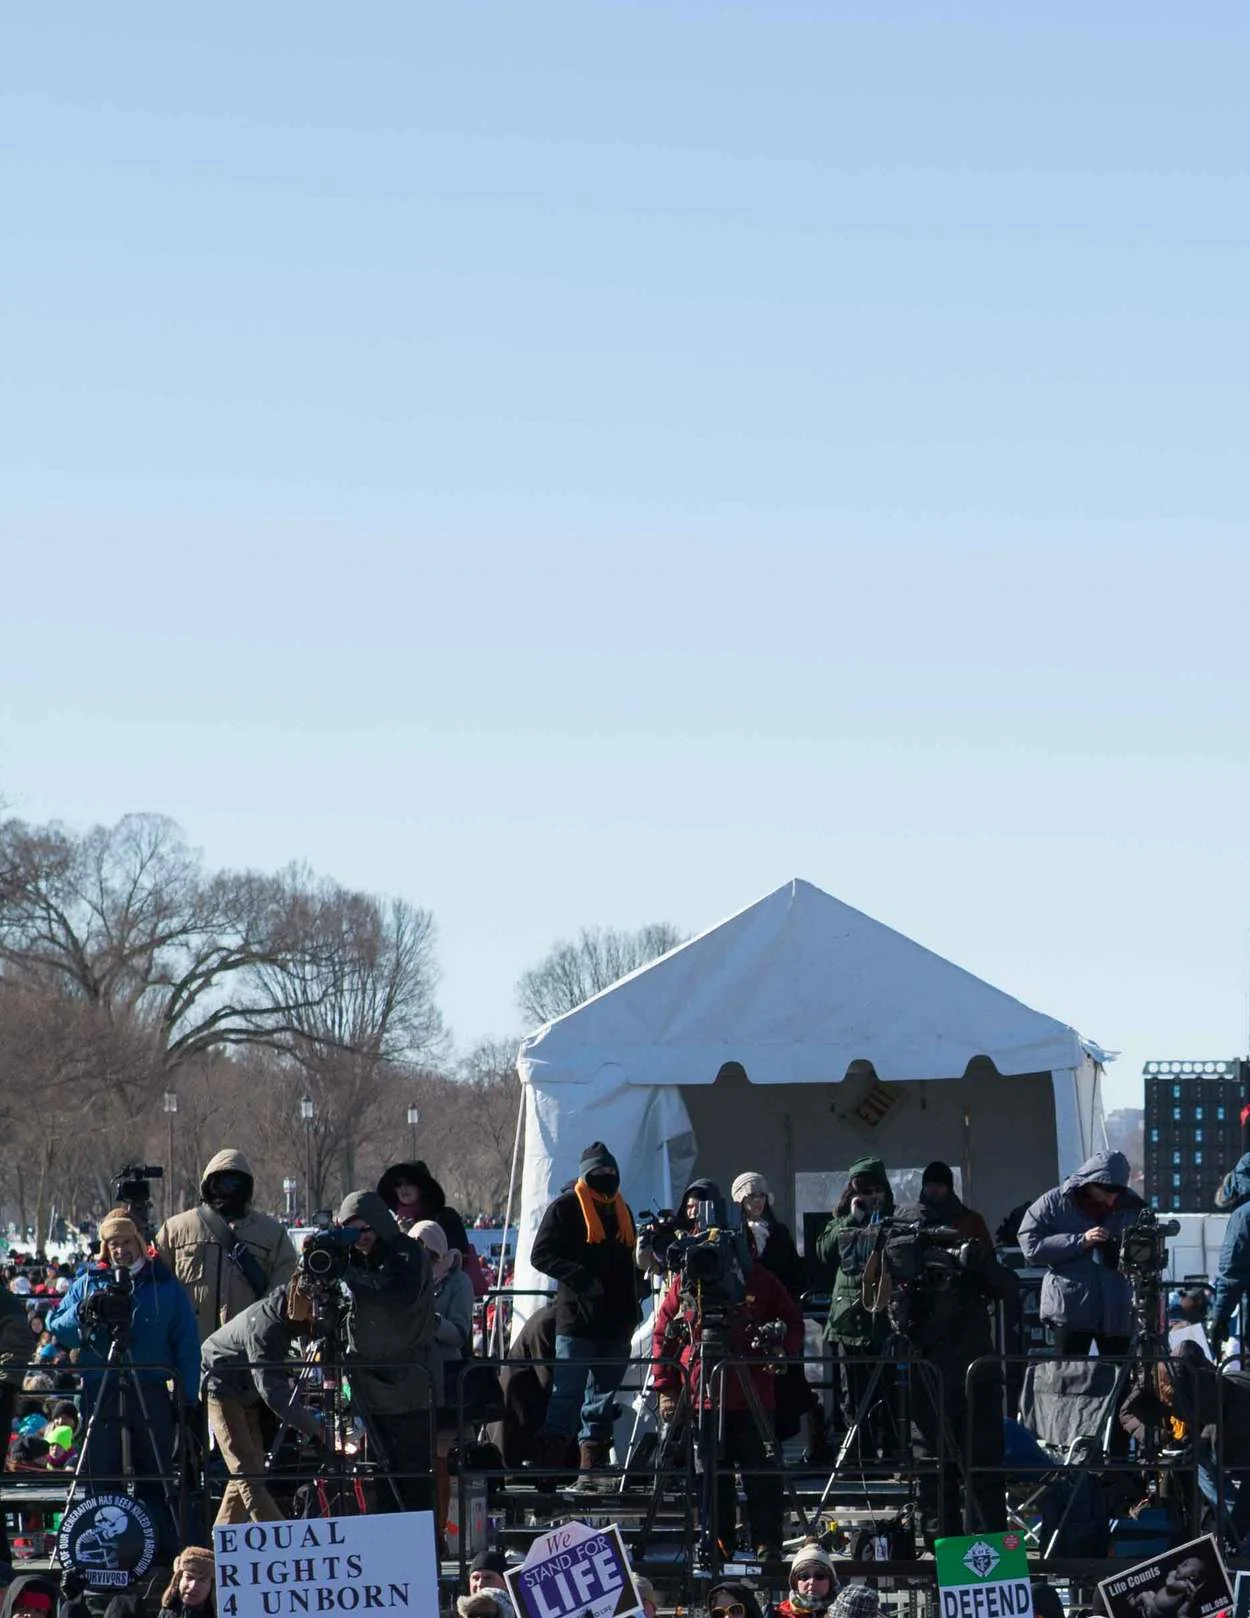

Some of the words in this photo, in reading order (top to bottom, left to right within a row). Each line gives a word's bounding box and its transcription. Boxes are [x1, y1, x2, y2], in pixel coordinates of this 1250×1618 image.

[63, 1497, 97, 1532] GENERATION
[98, 1494, 113, 1506] HAS
[130, 1504, 151, 1529] KILLED
[59, 1533, 70, 1550] OUR
[218, 1521, 346, 1553] EQUAL
[545, 1532, 571, 1555] We
[134, 1539, 156, 1577] ABORTION
[219, 1554, 363, 1588] RIGHTS
[524, 1554, 572, 1588] STAND
[575, 1536, 608, 1561] FOR
[86, 1569, 128, 1585] URVIVORS
[1109, 1576, 1128, 1598] Life
[1127, 1564, 1161, 1589] Counts
[223, 1593, 238, 1617] 4
[260, 1583, 410, 1615] UNBORN
